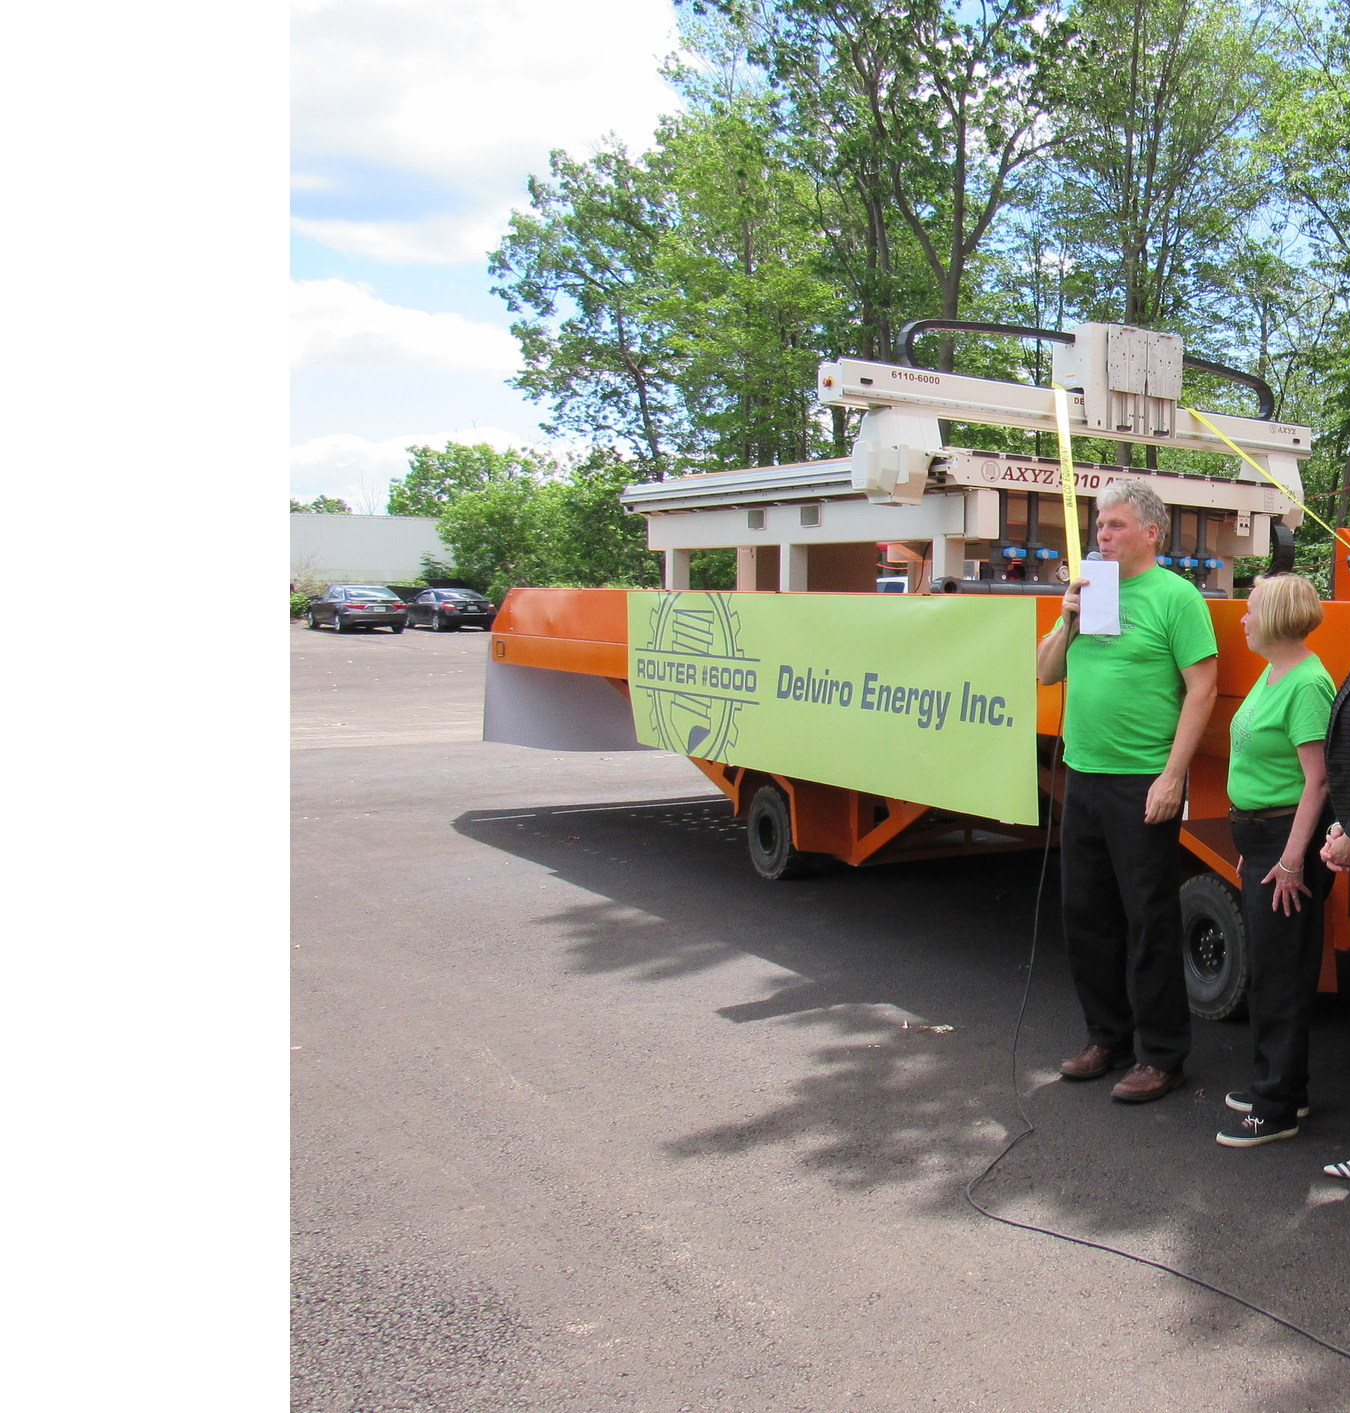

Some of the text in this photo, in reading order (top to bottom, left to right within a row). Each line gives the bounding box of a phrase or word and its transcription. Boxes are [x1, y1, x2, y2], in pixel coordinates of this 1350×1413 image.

[891, 370, 941, 385] 6110-6000
[1278, 426, 1297, 435] AXYZ
[1001, 466, 1056, 485] AXYZ
[637, 658, 757, 692] ROUTER #6000
[776, 664, 1014, 731] Delviro Energy Inc.
